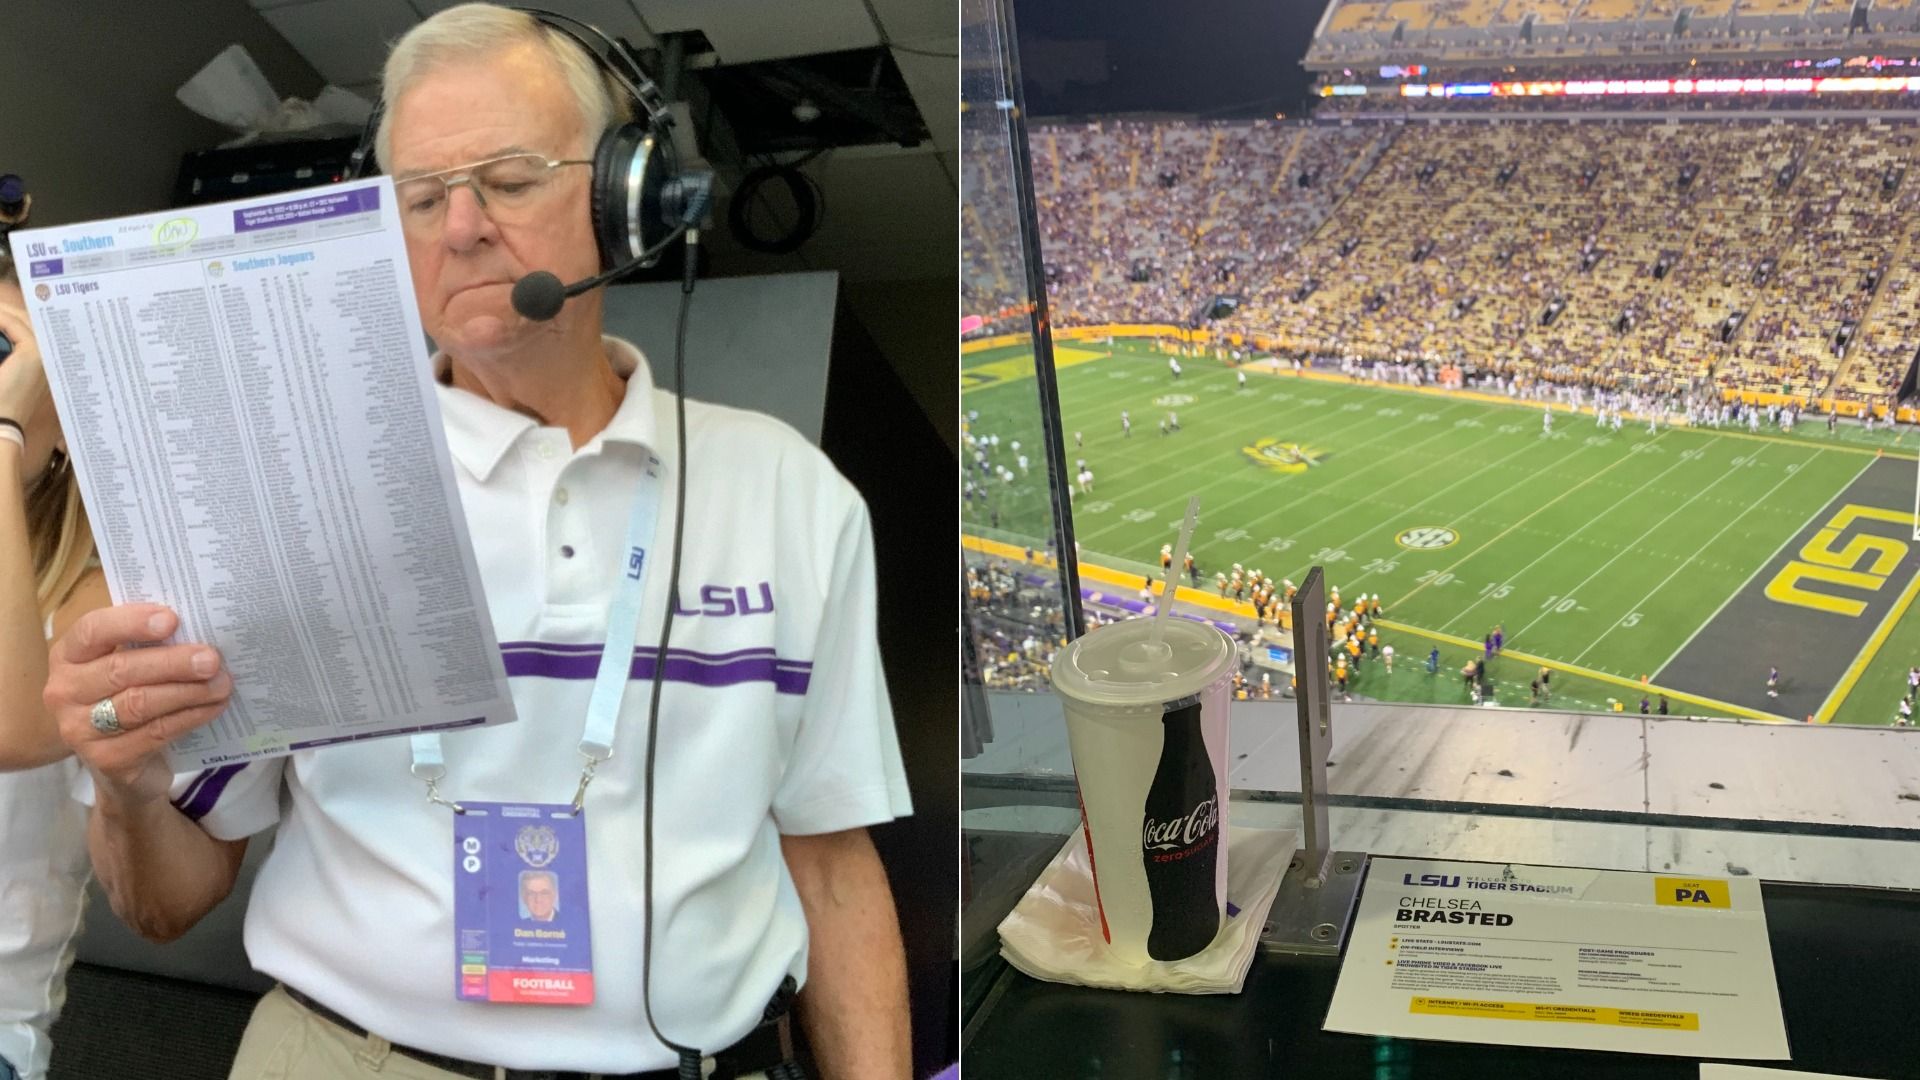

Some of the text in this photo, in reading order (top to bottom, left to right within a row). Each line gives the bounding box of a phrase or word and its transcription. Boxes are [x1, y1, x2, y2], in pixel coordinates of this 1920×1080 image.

[26, 235, 115, 258] LSU vs. Southern
[232, 251, 316, 273] Southern Jaguars
[55, 281, 99, 296] LSU Tigers
[627, 546, 646, 581] LSU
[1764, 503, 1920, 617] LSU
[1416, 570, 1455, 586] 20
[1478, 582, 1515, 599] 15
[673, 582, 774, 616] LSU
[1540, 595, 1577, 613] 10
[1622, 612, 1644, 628] 5
[467, 841, 478, 850] M
[468, 860, 476, 869] P
[1404, 874, 1573, 894] LSU TIGER STADIUM
[1399, 896, 1482, 911] CHELSEA
[1676, 888, 1711, 903] PA
[1396, 909, 1514, 926] BRASTED
[522, 956, 559, 965] Marketing
[513, 978, 575, 990] FOOTBALL
